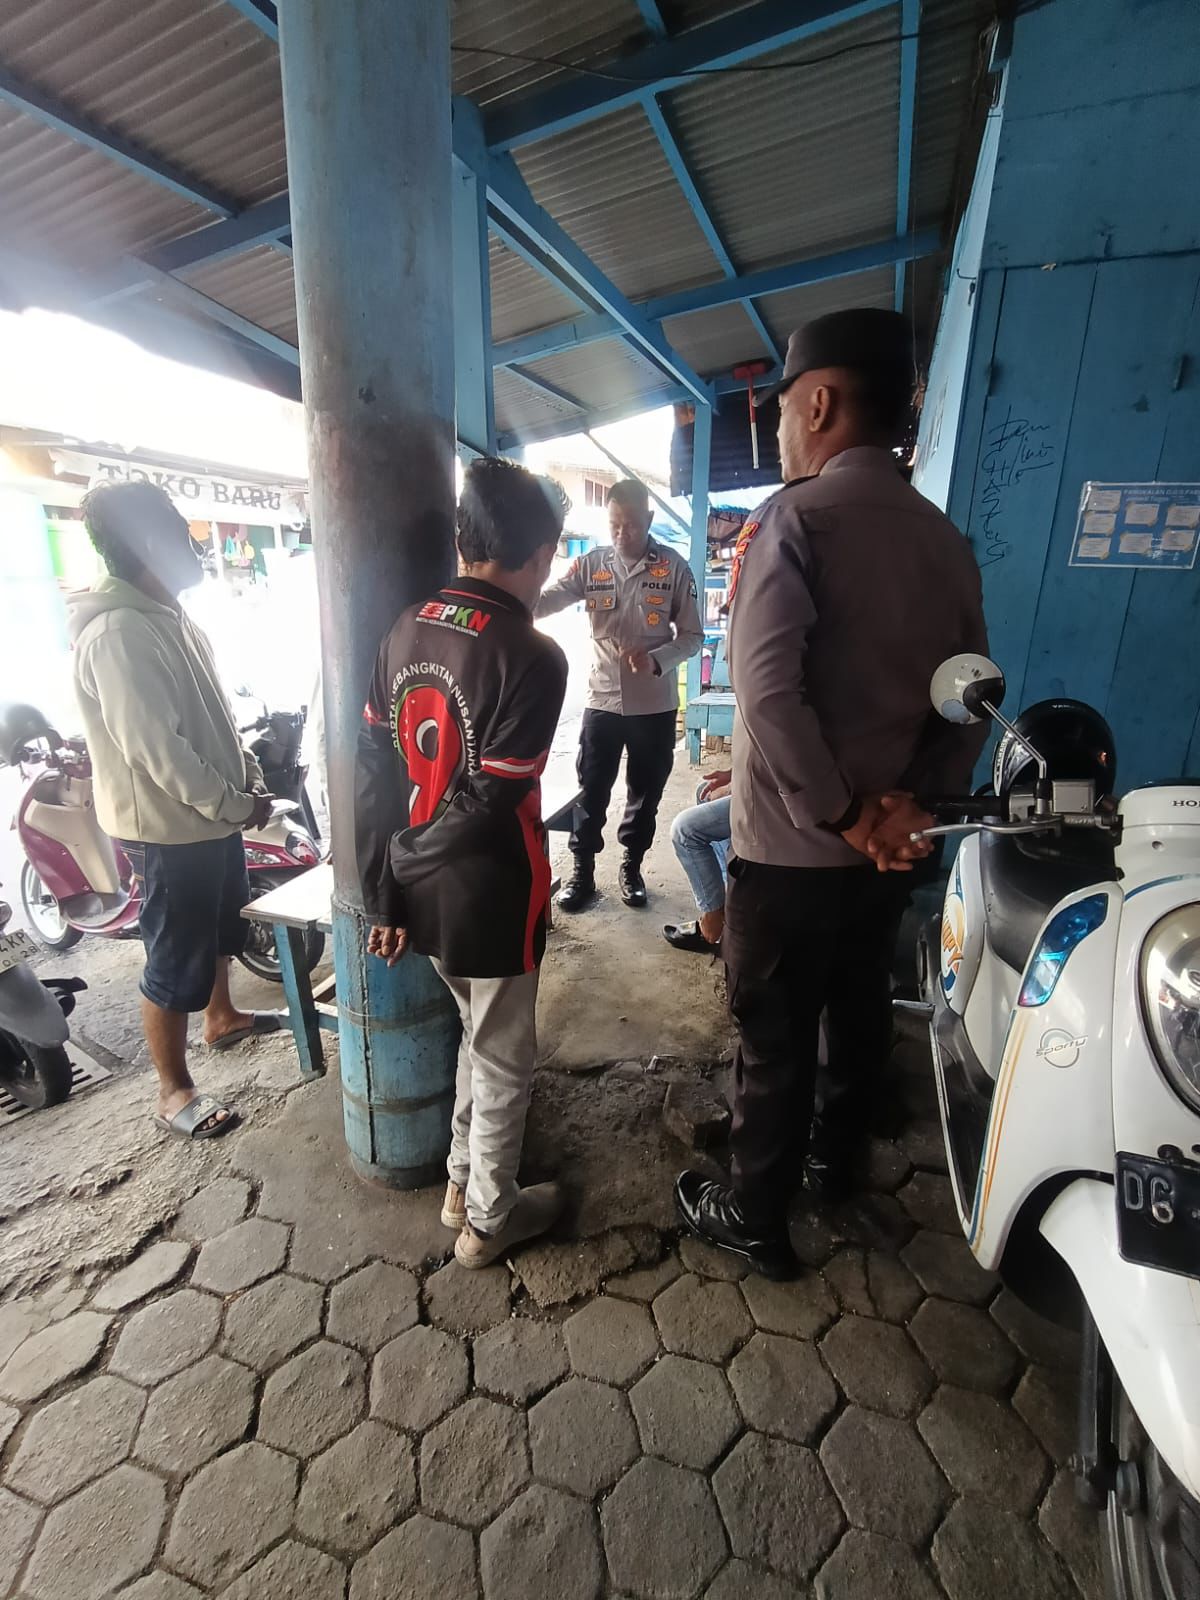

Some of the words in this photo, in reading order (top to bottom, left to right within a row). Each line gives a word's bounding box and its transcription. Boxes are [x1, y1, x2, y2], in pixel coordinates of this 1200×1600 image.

[211, 481, 281, 511] BARU
[642, 581, 672, 592] POLRI
[439, 604, 491, 632] PKN
[450, 685, 477, 776] NUSANTARA
